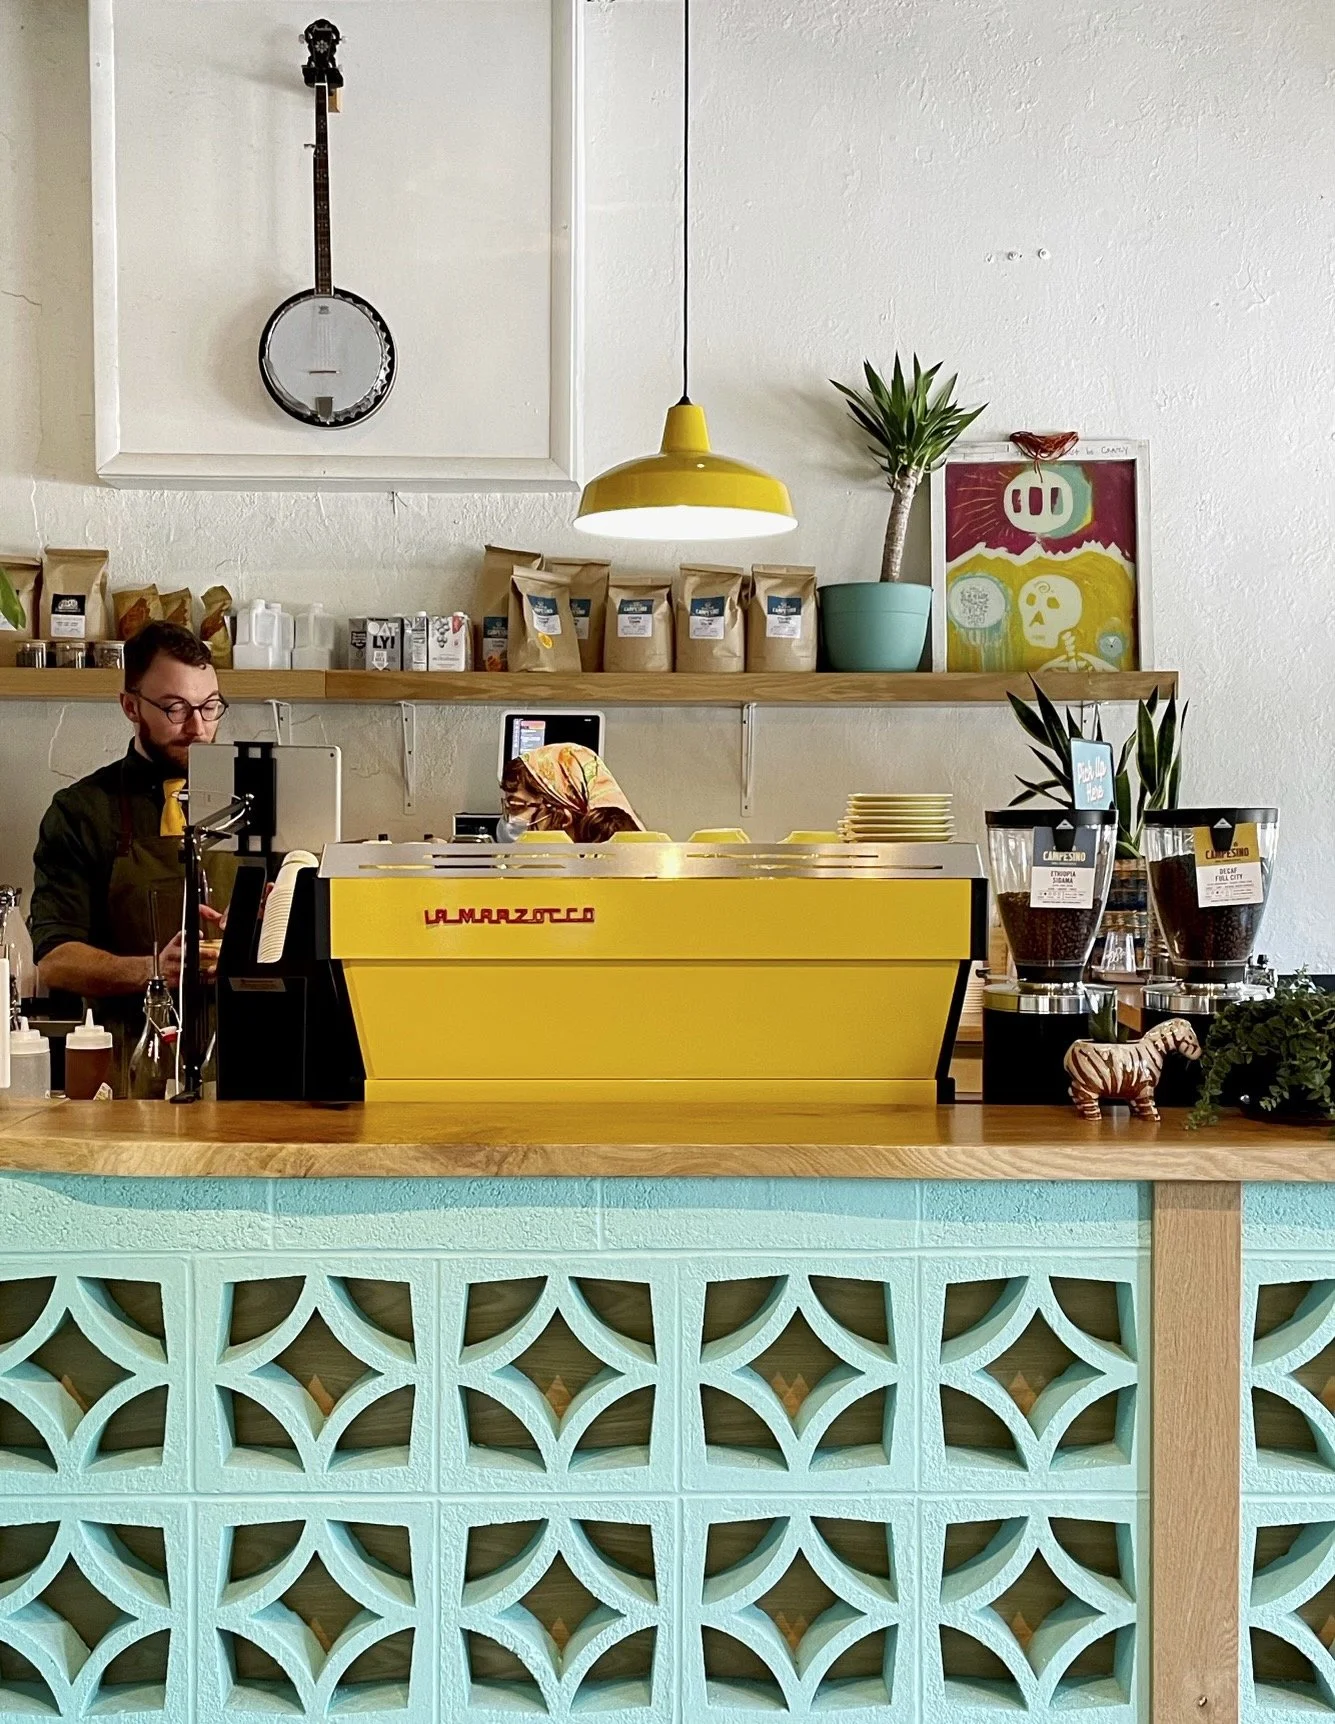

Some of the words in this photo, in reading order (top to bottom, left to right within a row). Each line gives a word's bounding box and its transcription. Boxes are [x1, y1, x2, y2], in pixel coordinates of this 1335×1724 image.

[372, 635, 396, 649] LY!
[1077, 759, 1095, 785] Pick
[1086, 782, 1105, 803] Here
[1042, 850, 1086, 862] CAMPESINO
[1219, 867, 1237, 875] DECAF
[1229, 873, 1243, 881] CITY
